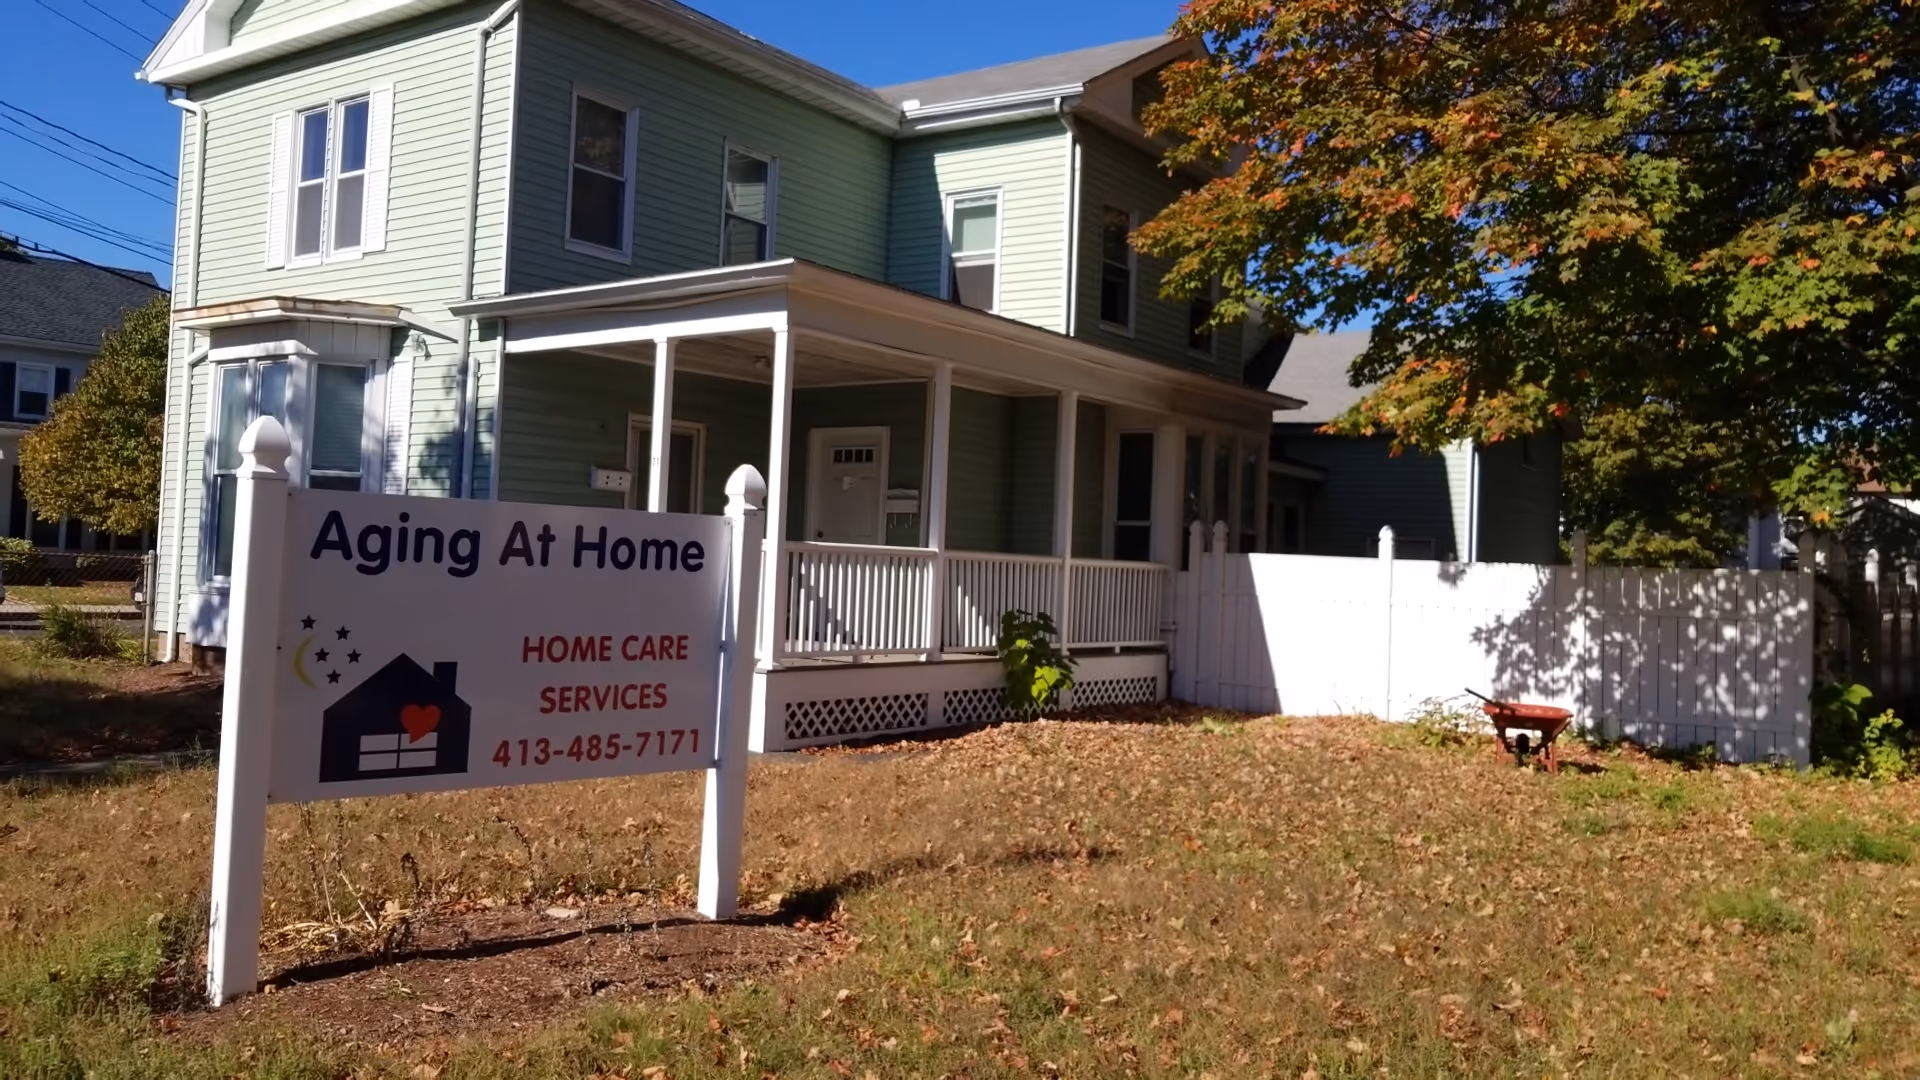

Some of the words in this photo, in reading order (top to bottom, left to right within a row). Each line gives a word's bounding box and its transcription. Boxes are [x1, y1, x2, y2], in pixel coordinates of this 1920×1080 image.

[309, 509, 481, 578] Aging
[498, 520, 557, 568] At
[572, 525, 705, 572] Home
[522, 635, 613, 664] HOME
[621, 634, 689, 662] CARE
[539, 682, 668, 715] SERVICES
[491, 728, 700, 768] 413-485-7171
